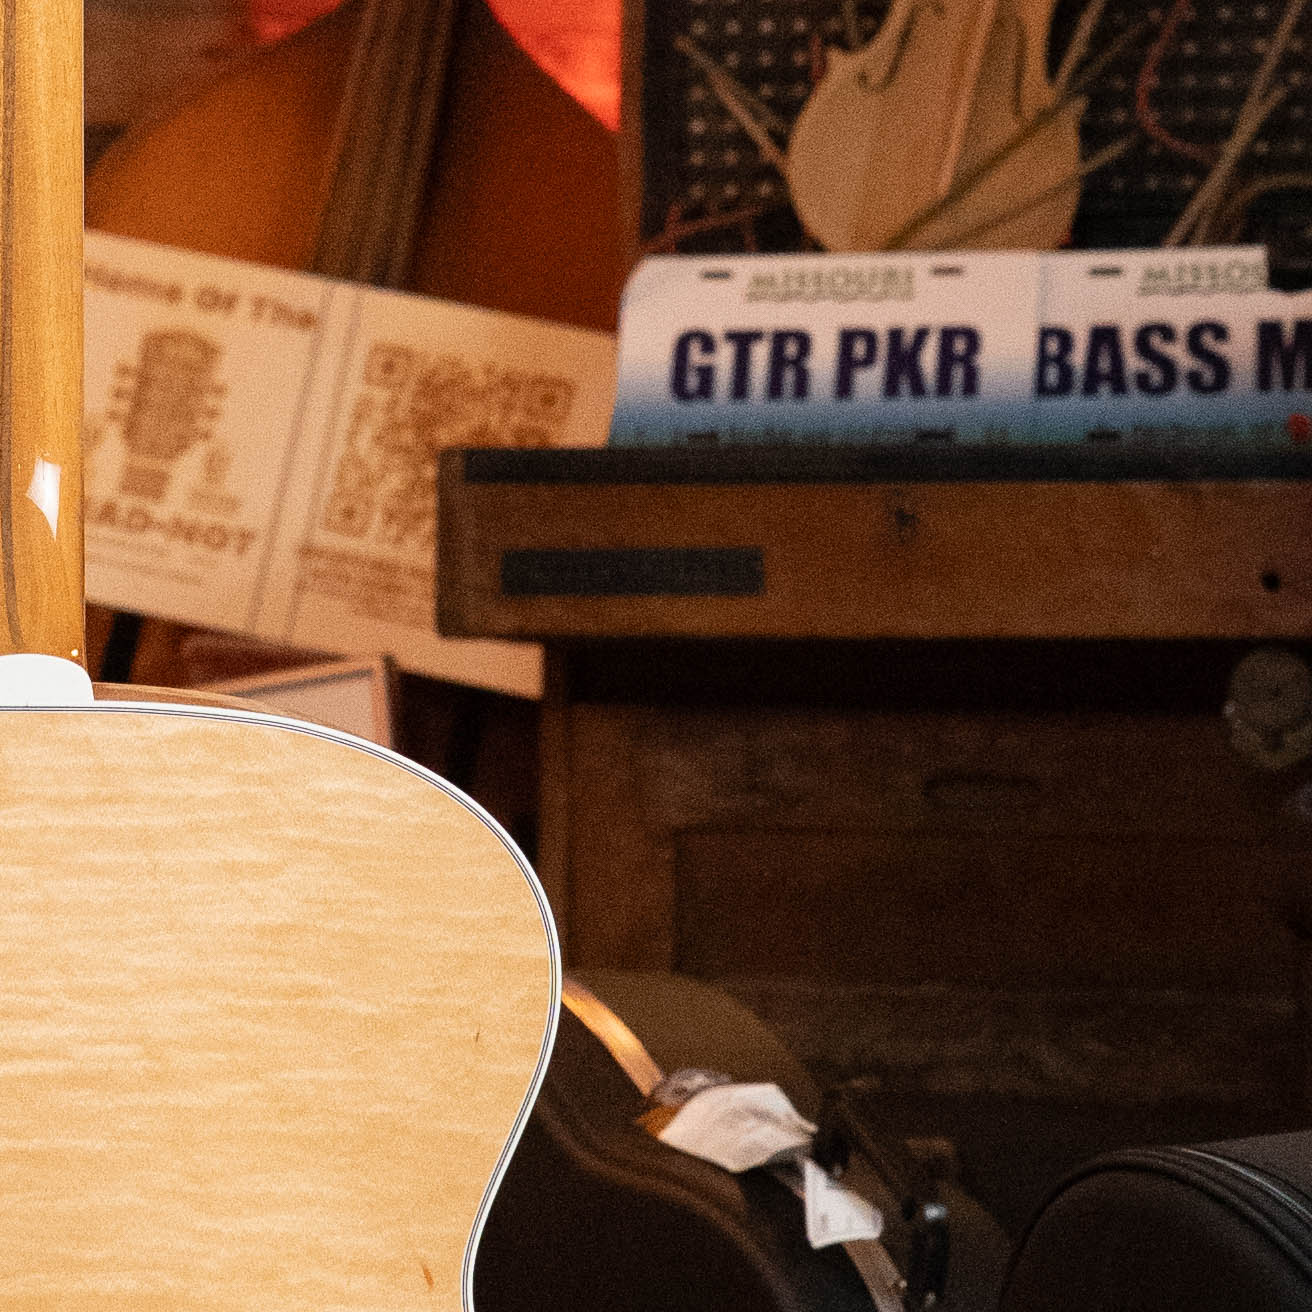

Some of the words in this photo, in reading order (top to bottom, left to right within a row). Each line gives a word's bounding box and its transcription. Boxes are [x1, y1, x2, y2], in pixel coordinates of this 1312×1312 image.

[746, 264, 915, 303] MISSOURI
[670, 327, 814, 403] GTR
[834, 325, 982, 399] PKR
[1033, 320, 1230, 397] BASS
